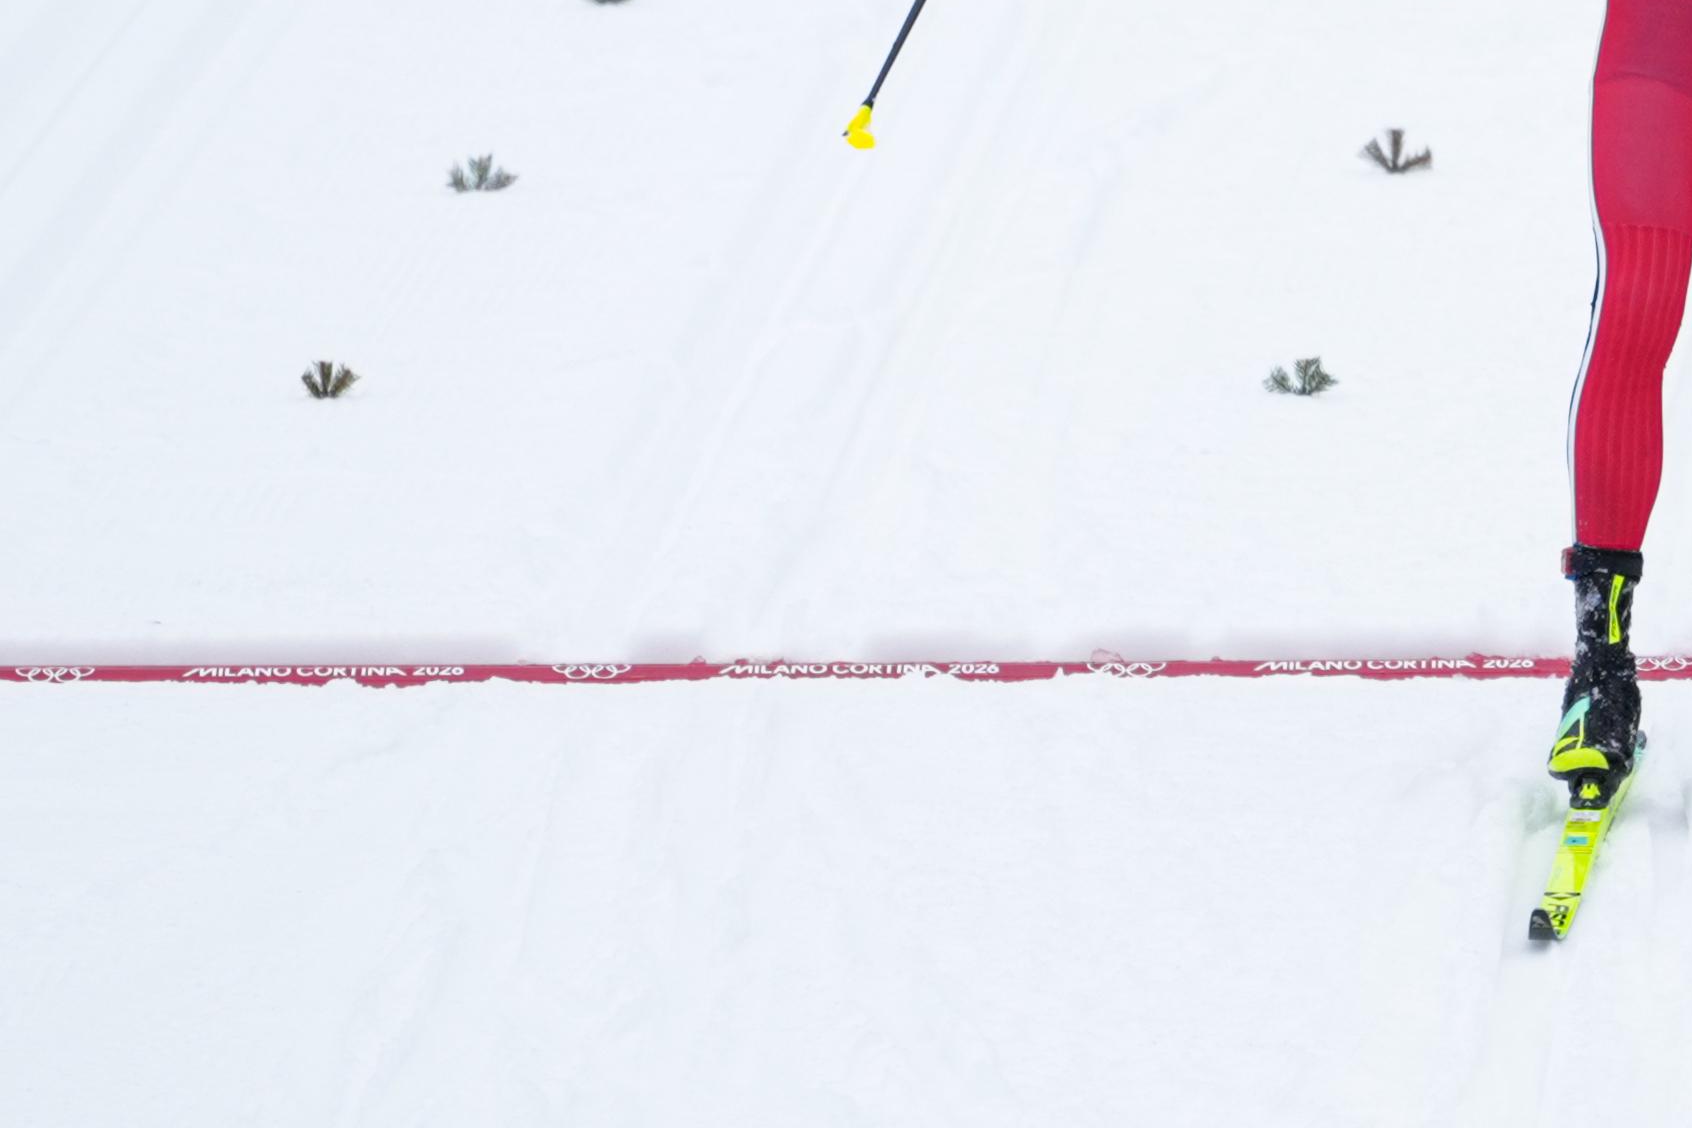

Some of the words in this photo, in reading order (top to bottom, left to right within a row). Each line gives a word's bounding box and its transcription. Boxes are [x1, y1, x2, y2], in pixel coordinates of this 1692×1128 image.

[718, 663, 828, 675] MILANO
[832, 663, 942, 675] CORTINA
[949, 663, 1000, 674] 2026
[1254, 660, 1362, 671] MILANO
[1367, 660, 1477, 670] CORTINA
[1482, 659, 1535, 669] 2026
[182, 666, 291, 678] MILANO
[296, 666, 408, 677] CORTINA
[412, 666, 465, 677] 2026
